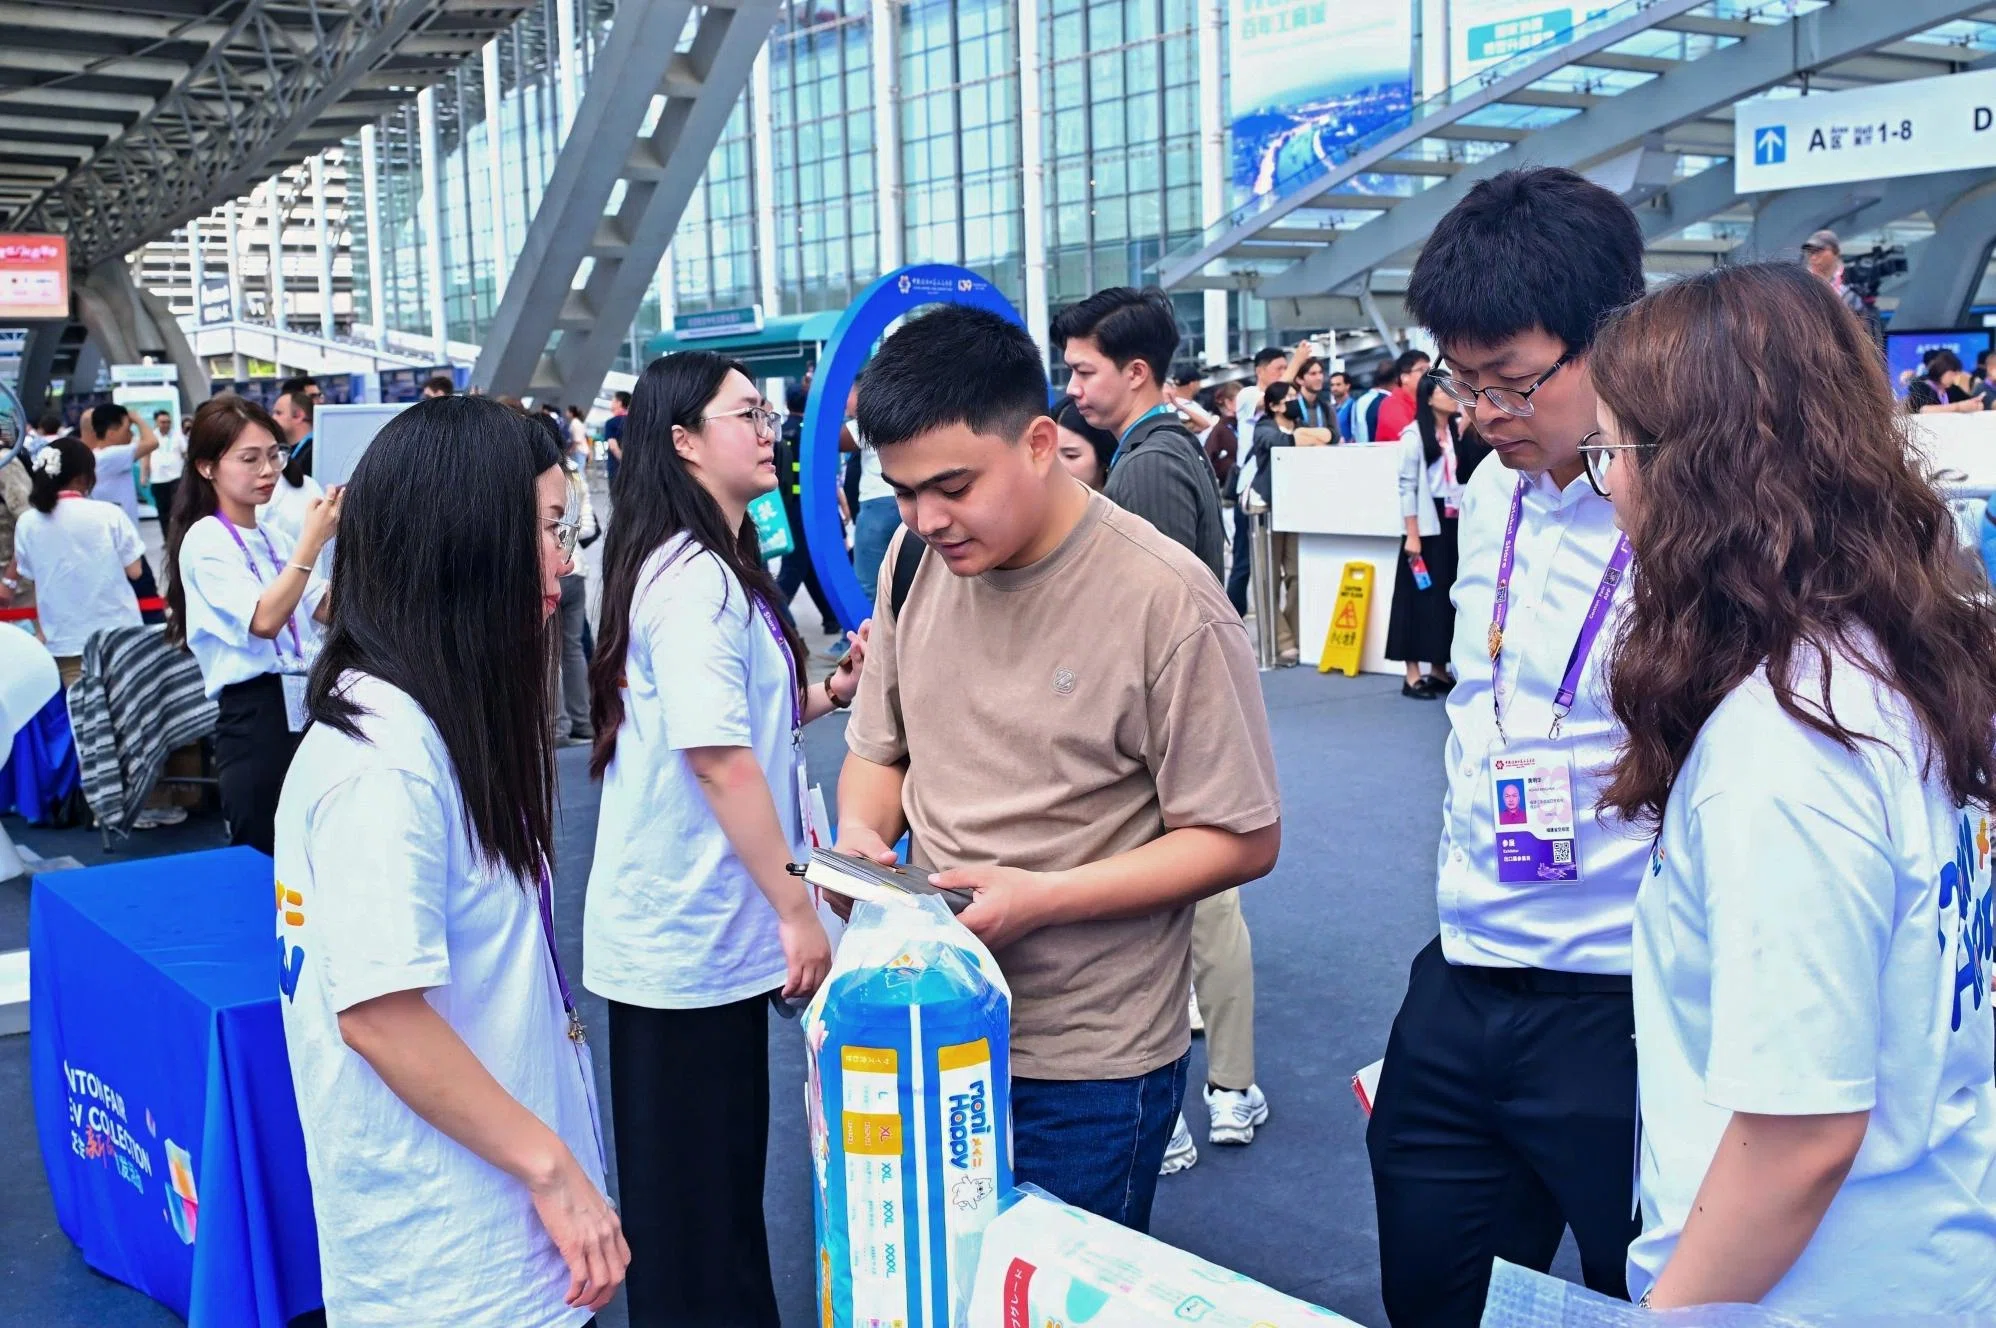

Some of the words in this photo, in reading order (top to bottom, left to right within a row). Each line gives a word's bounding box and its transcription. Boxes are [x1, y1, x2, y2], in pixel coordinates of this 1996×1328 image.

[1809, 128, 1826, 152] A
[1878, 120, 1912, 143] 1-8
[1974, 106, 1993, 132] D
[1502, 539, 1512, 569] Share
[763, 610, 777, 633] Share
[878, 1091, 888, 1100] L
[970, 1080, 991, 1134] moni
[880, 1126, 891, 1142] XL
[949, 1094, 970, 1169] Happy
[881, 1162, 893, 1184] XXL
[883, 1200, 894, 1228] XXXL
[885, 1243, 897, 1278] XXXXL
